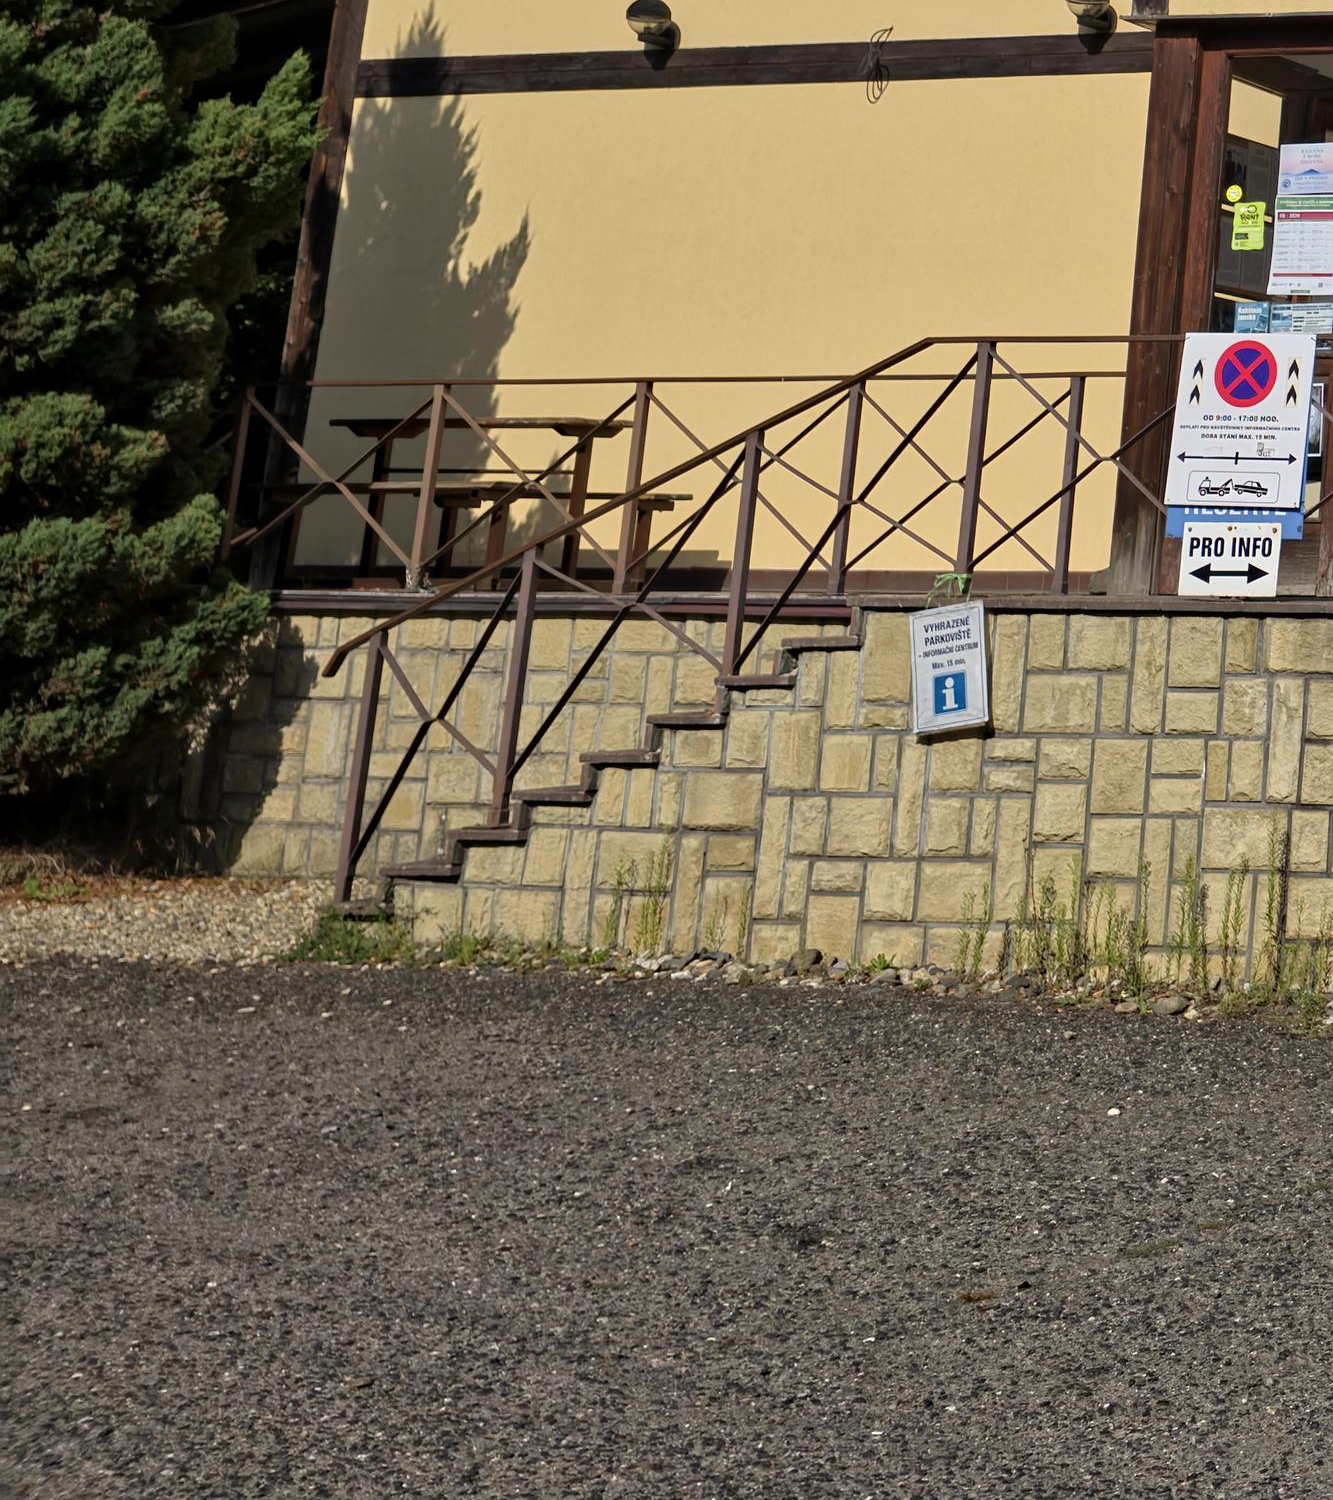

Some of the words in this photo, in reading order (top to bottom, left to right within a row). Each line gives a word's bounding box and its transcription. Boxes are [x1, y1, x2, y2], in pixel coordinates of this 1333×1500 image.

[1260, 415, 1279, 423] HOD.
[1189, 537, 1225, 557] PRO
[1231, 537, 1273, 557] INFO
[923, 615, 970, 633] VYHRAZENÉ
[924, 628, 971, 647] PARKOVIŠTĚ
[922, 646, 954, 658] INFORMAČNÍ
[955, 641, 979, 652] CENTRUM
